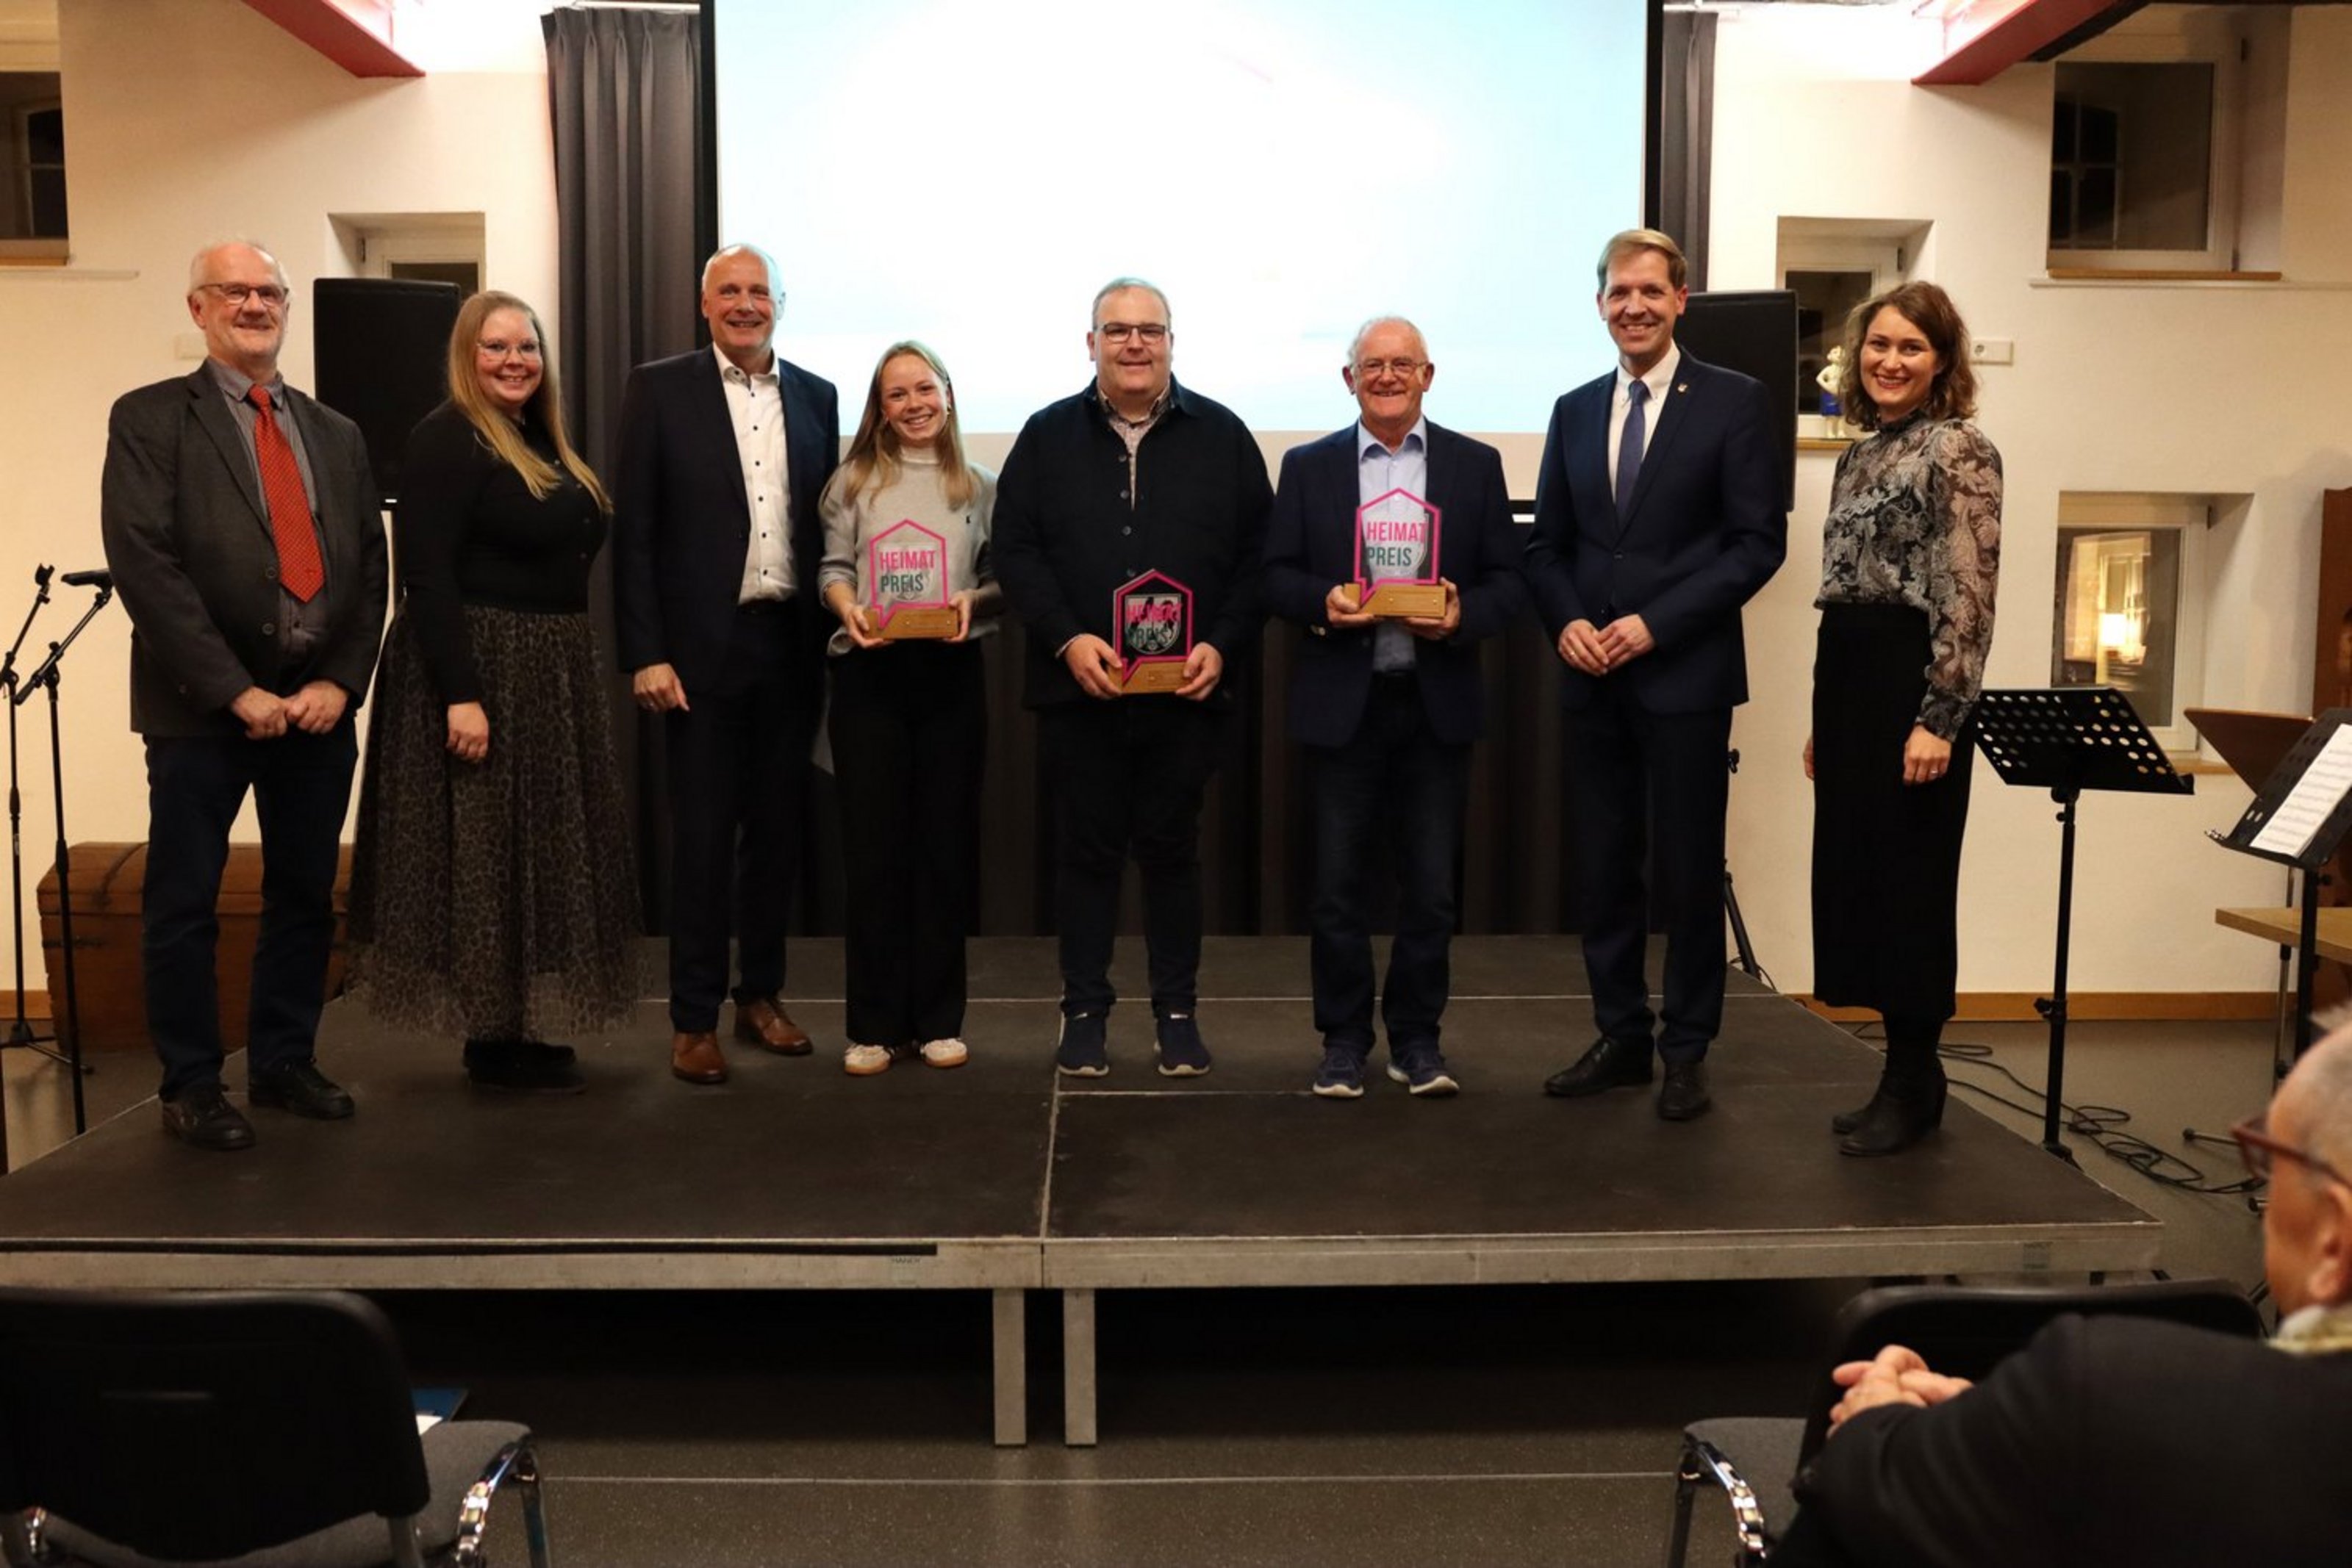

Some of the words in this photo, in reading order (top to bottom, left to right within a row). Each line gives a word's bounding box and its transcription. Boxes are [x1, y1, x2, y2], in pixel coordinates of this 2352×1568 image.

[1366, 521, 1428, 542] HEIMAT
[880, 550, 936, 570] HEIMAT
[1366, 547, 1412, 567] PREIS
[881, 573, 924, 593] PREIS
